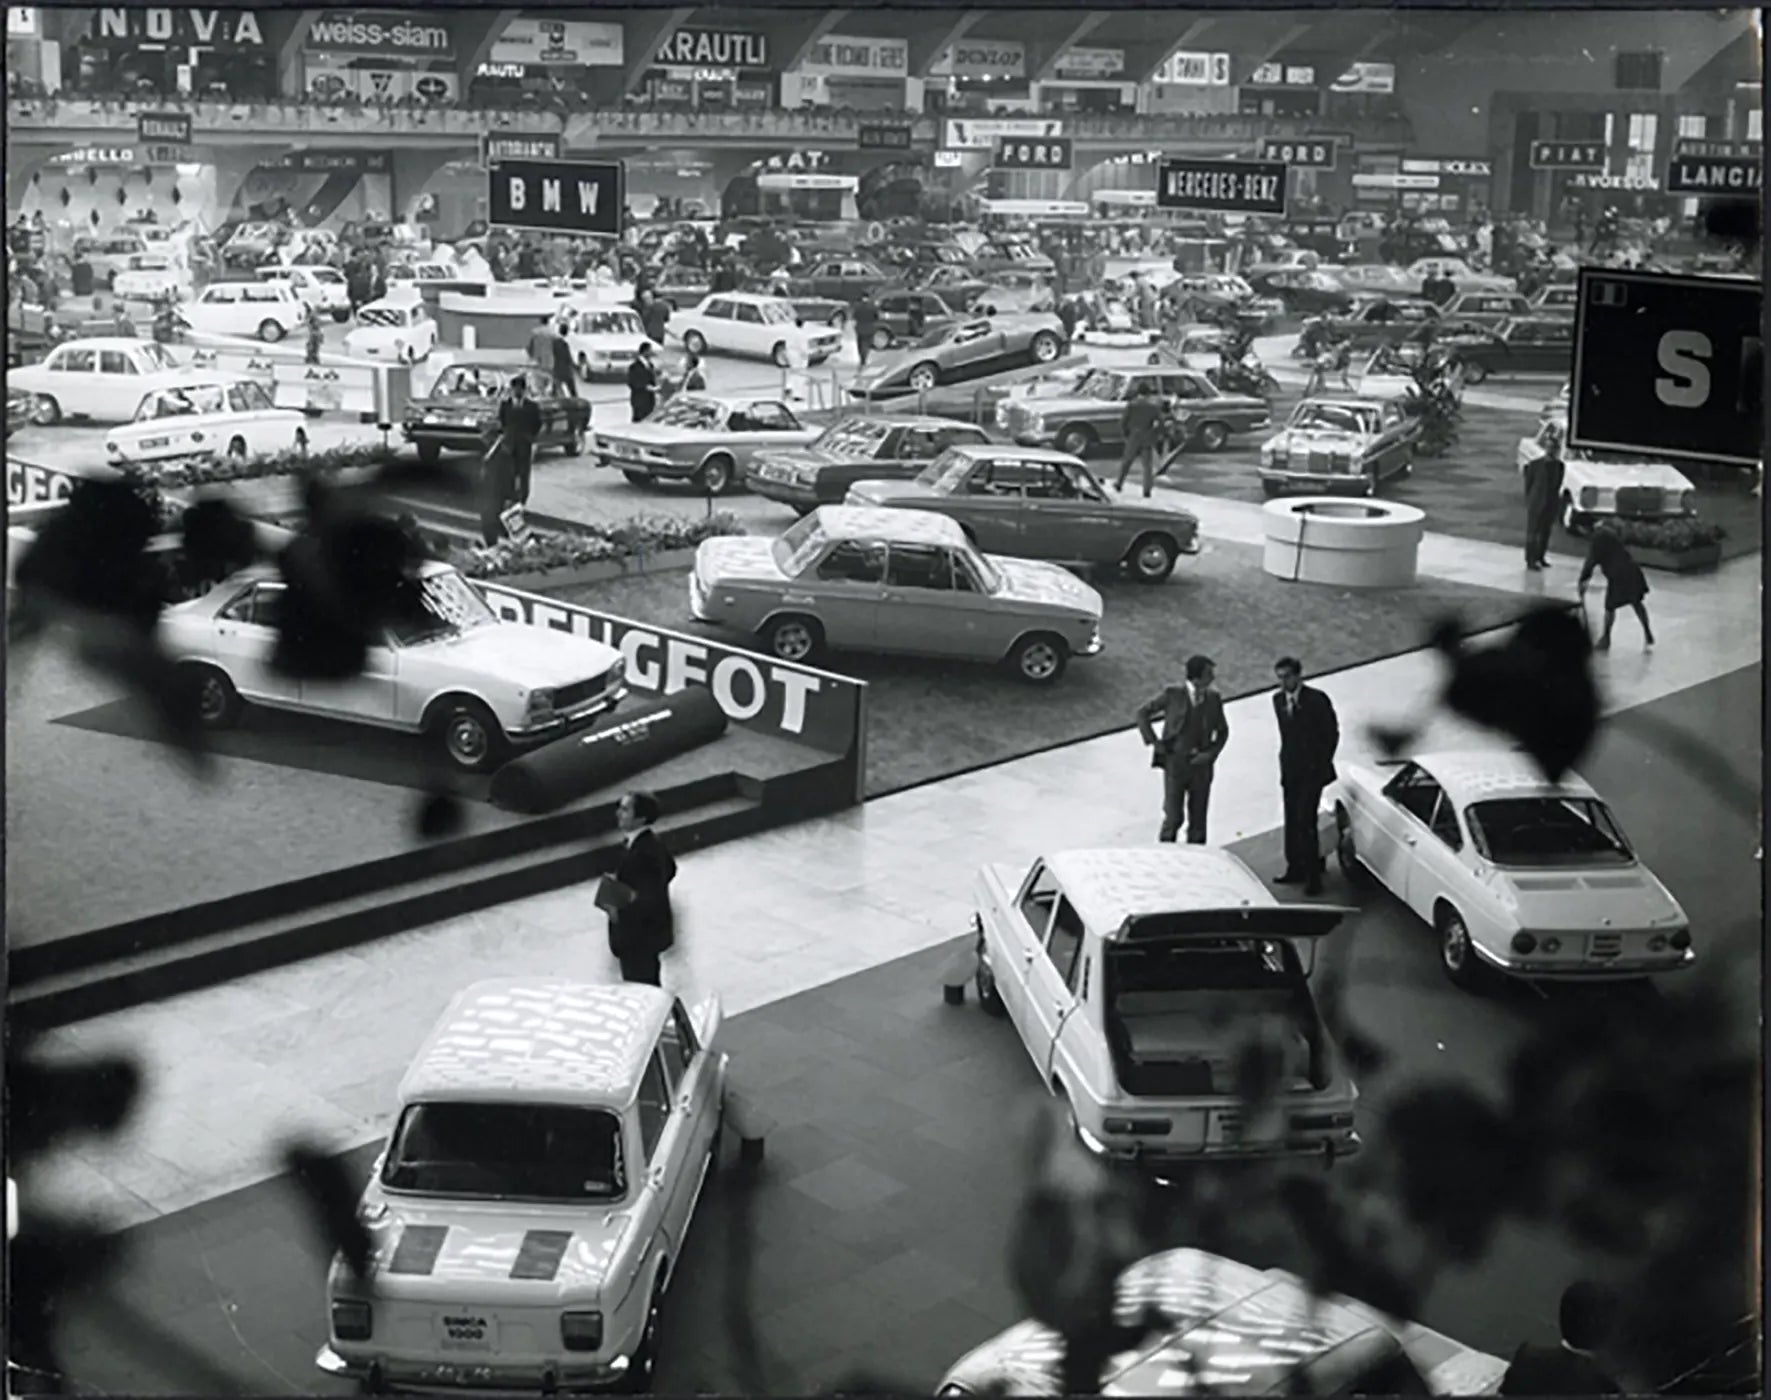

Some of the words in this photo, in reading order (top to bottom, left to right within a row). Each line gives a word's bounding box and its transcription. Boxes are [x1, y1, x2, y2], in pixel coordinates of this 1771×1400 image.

[312, 16, 448, 48] weiss-siam
[658, 31, 765, 64] KRAUTLI
[1002, 144, 1063, 163] FORD
[1266, 145, 1326, 162] FORD
[509, 176, 599, 216] BMW
